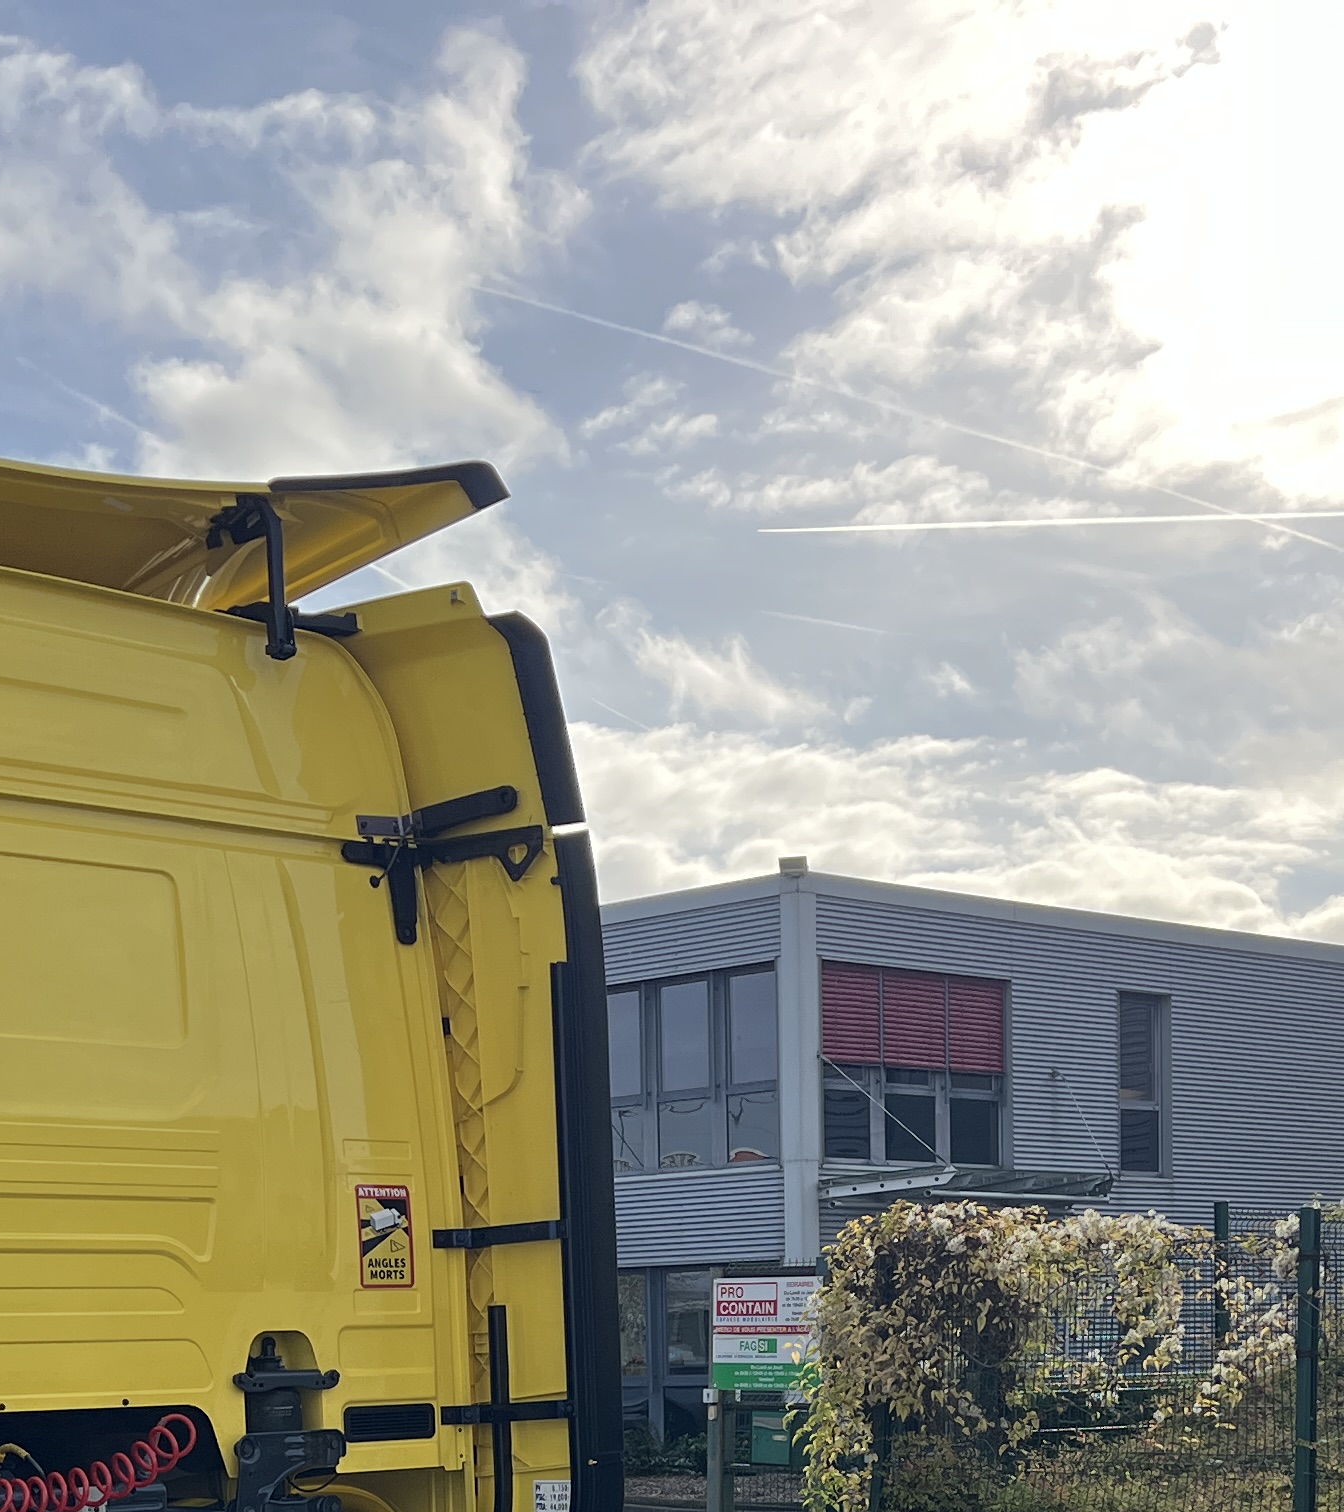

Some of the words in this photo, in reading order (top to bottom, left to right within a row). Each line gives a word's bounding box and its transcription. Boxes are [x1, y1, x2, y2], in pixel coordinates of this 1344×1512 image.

[358, 1187, 407, 1197] ATTENTION
[367, 1258, 406, 1269] ANGLES
[370, 1269, 405, 1280] MORTS
[720, 1286, 744, 1298] PRO
[720, 1302, 774, 1314] CONTAIN
[739, 1340, 768, 1351] FAGSI
